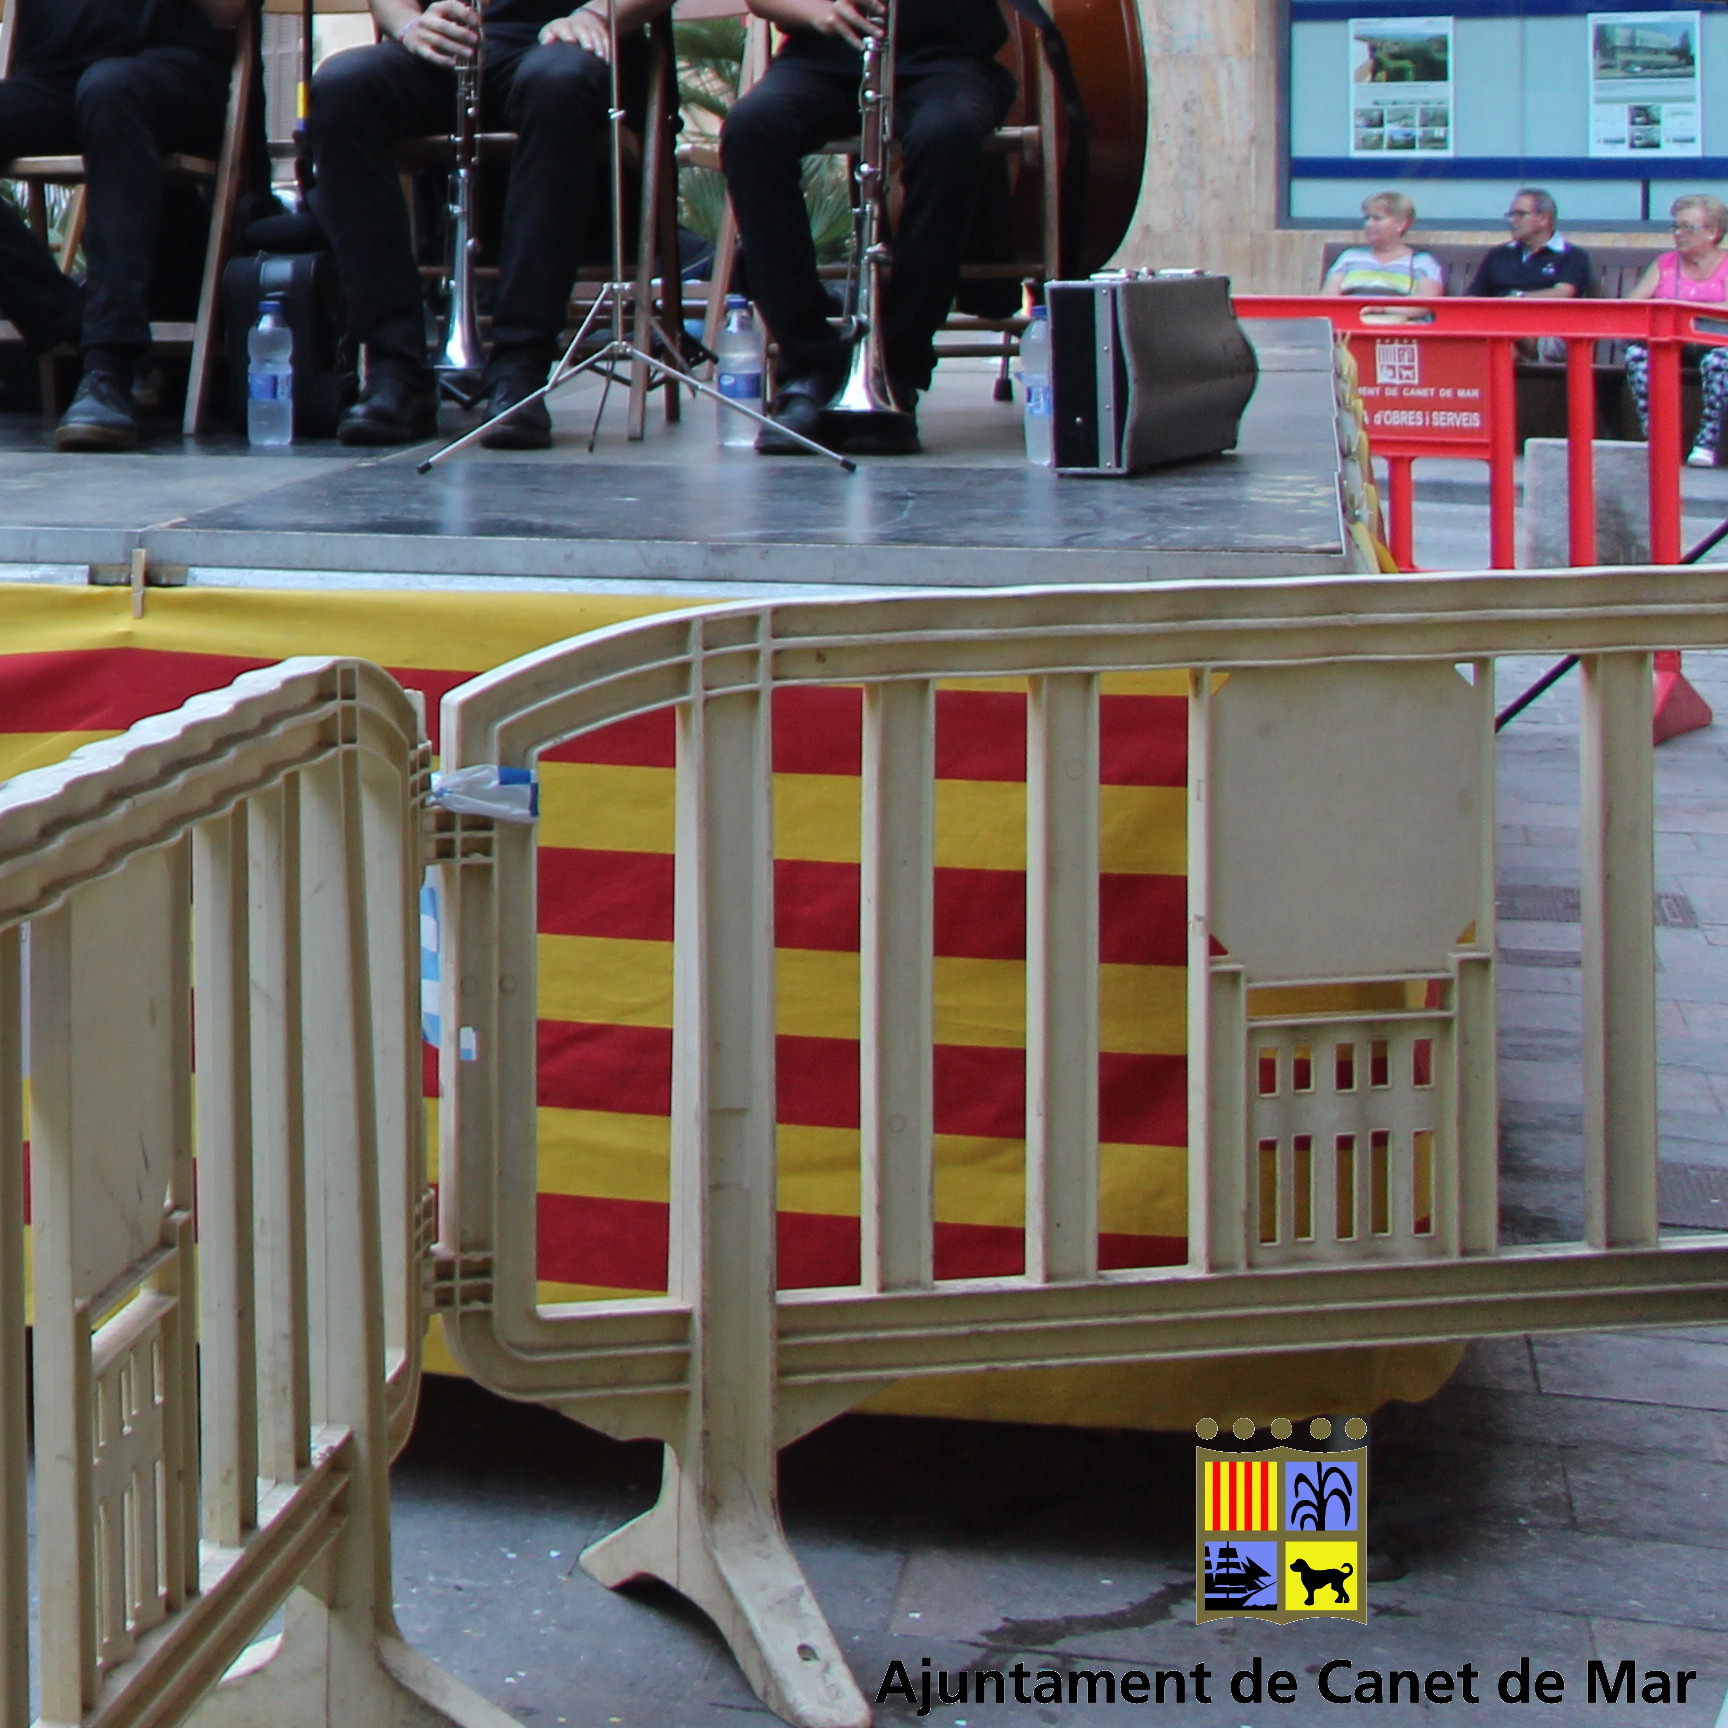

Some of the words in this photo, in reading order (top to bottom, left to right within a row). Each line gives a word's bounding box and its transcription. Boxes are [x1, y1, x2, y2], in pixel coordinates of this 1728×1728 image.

[1385, 387, 1398, 396] DE
[1402, 387, 1435, 398] CANET
[1439, 388, 1452, 397] DE
[1457, 388, 1479, 398] MAR
[1374, 410, 1423, 425] d'OBRES
[1432, 411, 1481, 427] SERVEIS
